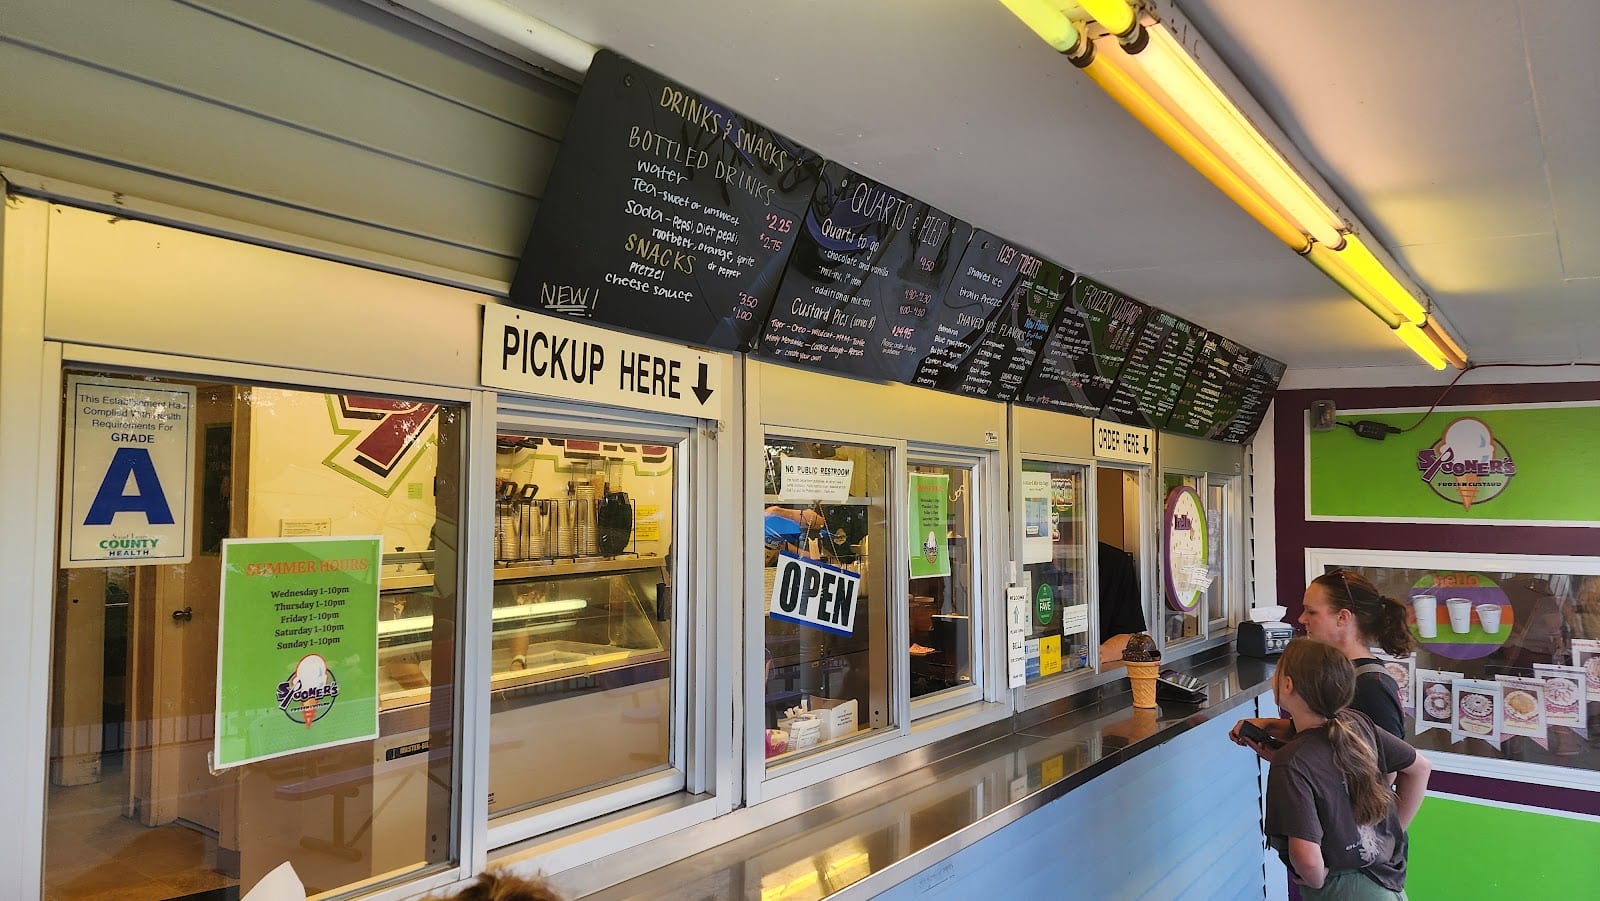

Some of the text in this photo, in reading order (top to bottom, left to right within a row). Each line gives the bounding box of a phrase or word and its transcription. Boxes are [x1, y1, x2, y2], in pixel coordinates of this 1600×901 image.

[660, 86, 722, 135] DRINKS
[735, 128, 787, 172] SNACKS
[628, 126, 776, 206] BOTTLED DRINKS
[691, 201, 701, 210] or
[704, 206, 740, 227] unsweet
[851, 182, 913, 231] QUARTS
[696, 223, 716, 237] Diet
[821, 218, 879, 261] Quarts to go
[625, 234, 697, 275] SNACKS
[737, 252, 755, 267] sprite
[996, 243, 1043, 280] ICEY TREATS
[708, 261, 742, 279] dr pepper
[859, 260, 870, 271] and
[540, 282, 600, 317] NEW!
[814, 285, 850, 302] additional
[959, 286, 980, 301] brain
[791, 298, 830, 325] Custard
[770, 318, 786, 332] Tiger
[957, 312, 985, 330] SHAVED
[985, 321, 997, 335] ICE
[1000, 323, 1027, 342] FLAVORS
[502, 324, 681, 399] PICKUP HERE
[80, 394, 100, 403] This
[92, 419, 173, 431] Requirements For
[111, 433, 155, 443] GRADE
[1098, 427, 1140, 455] ORDER HERE
[786, 465, 794, 473] NO
[797, 466, 818, 474] PUBLIC
[83, 448, 175, 525] A
[99, 539, 159, 549] COUNTY
[247, 559, 368, 576] SUMMER HOURS
[1431, 572, 1479, 587] hello
[271, 586, 350, 599] Wednesday 1-10pm
[779, 562, 855, 626] OPEN
[275, 599, 345, 612] Thursday 1-10pm
[1040, 601, 1051, 611] FAVE
[281, 611, 340, 624] Friday 1-10pm
[275, 623, 344, 637] Saturday 1-10pm
[277, 636, 340, 650] Sunday 1-10pm
